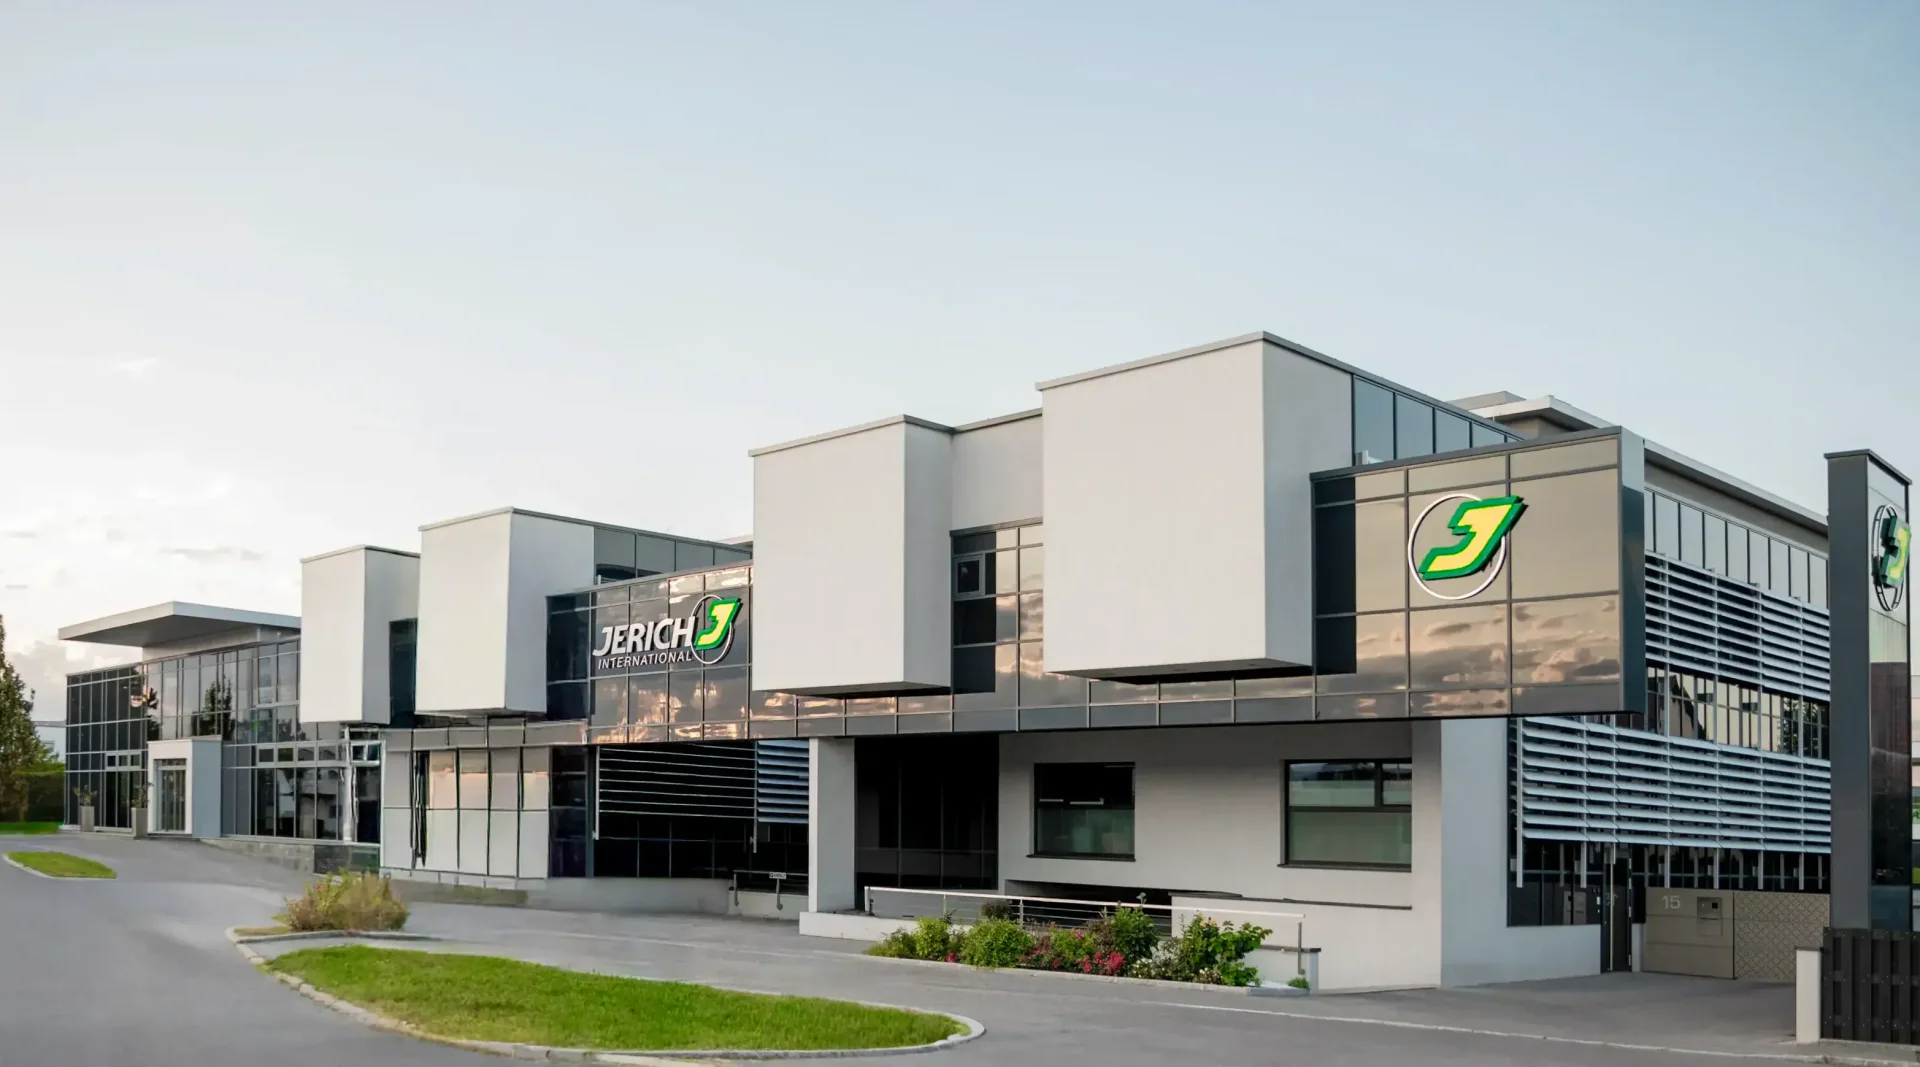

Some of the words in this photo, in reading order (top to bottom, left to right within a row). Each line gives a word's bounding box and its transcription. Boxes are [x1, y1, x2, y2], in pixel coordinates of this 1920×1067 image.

[592, 615, 696, 657] JERICH
[598, 651, 693, 670] INTERNATIONAL
[1662, 895, 1681, 910] 15
